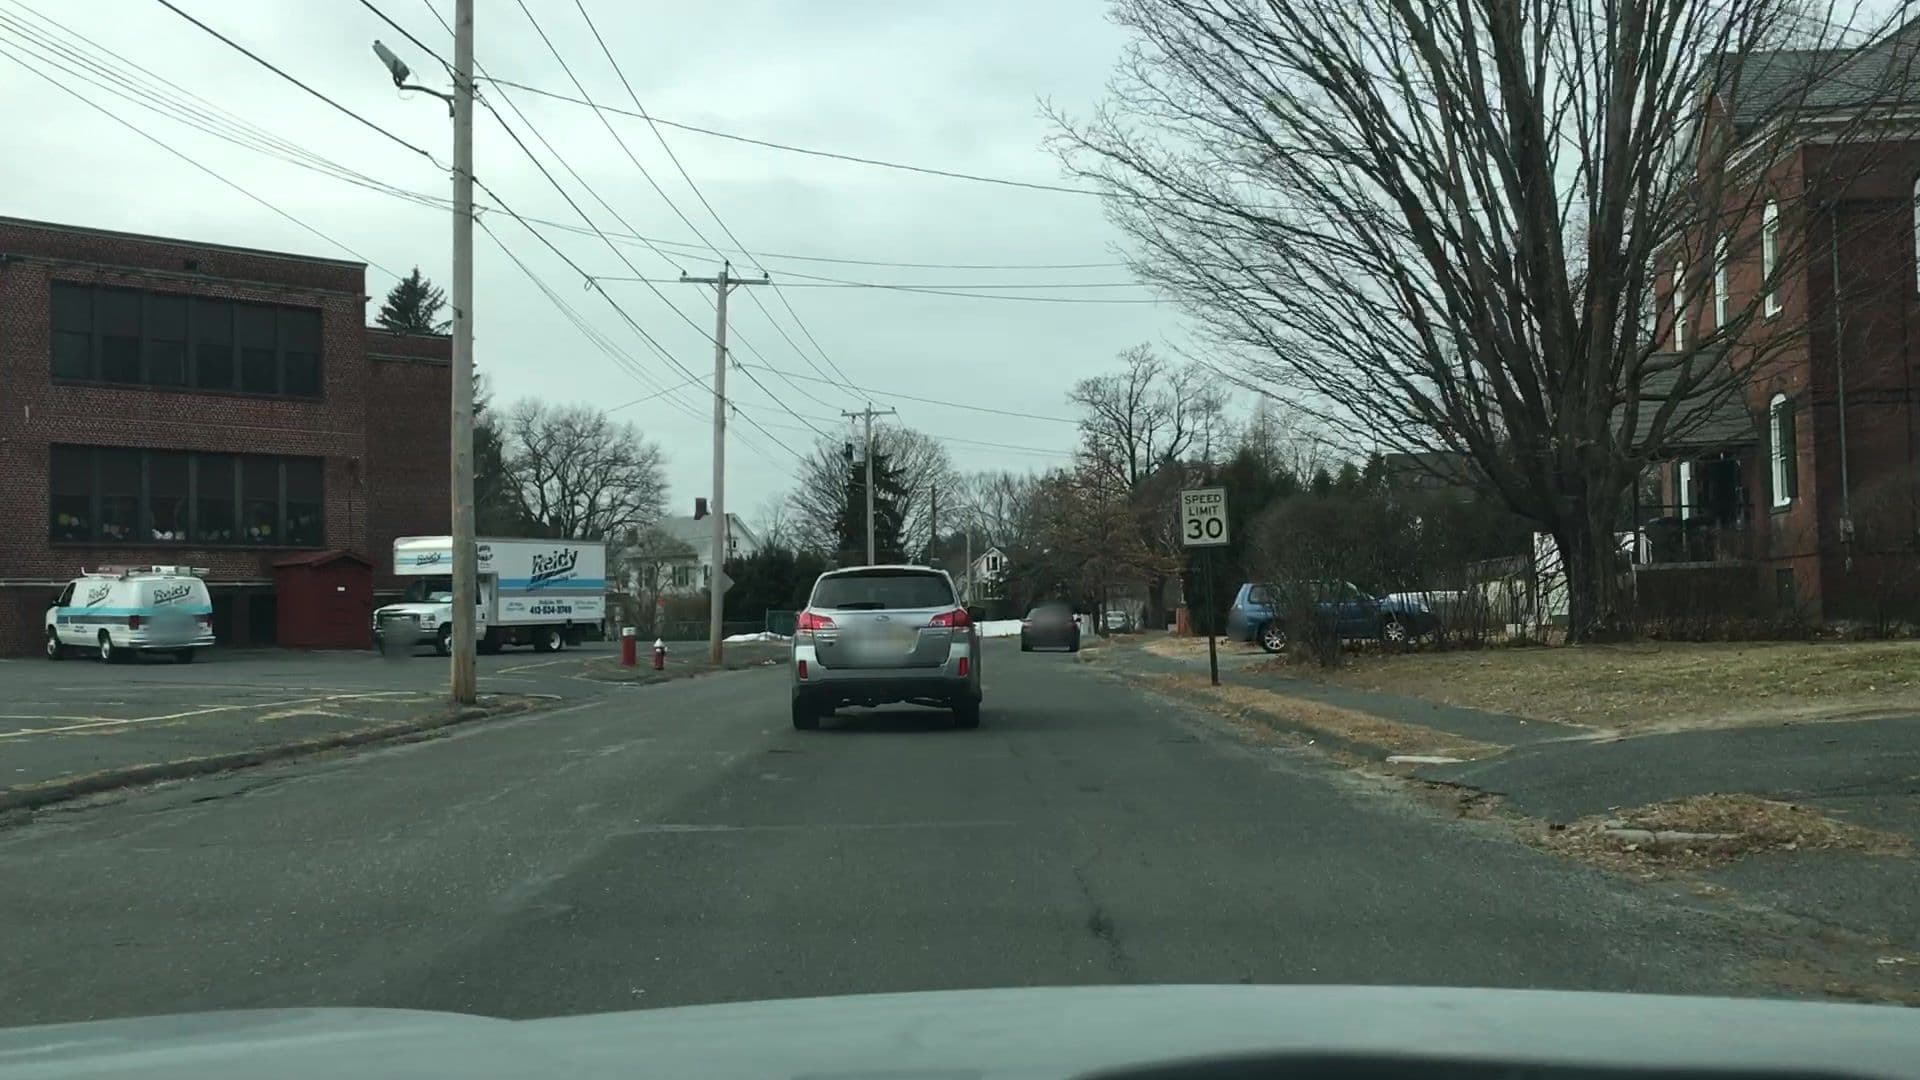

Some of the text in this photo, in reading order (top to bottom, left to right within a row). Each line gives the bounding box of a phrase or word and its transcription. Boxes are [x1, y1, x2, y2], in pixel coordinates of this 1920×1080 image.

[1184, 494, 1221, 504] SPEED
[1189, 505, 1218, 516] LIMIT
[1187, 517, 1223, 539] 30
[532, 548, 578, 575] Reidy
